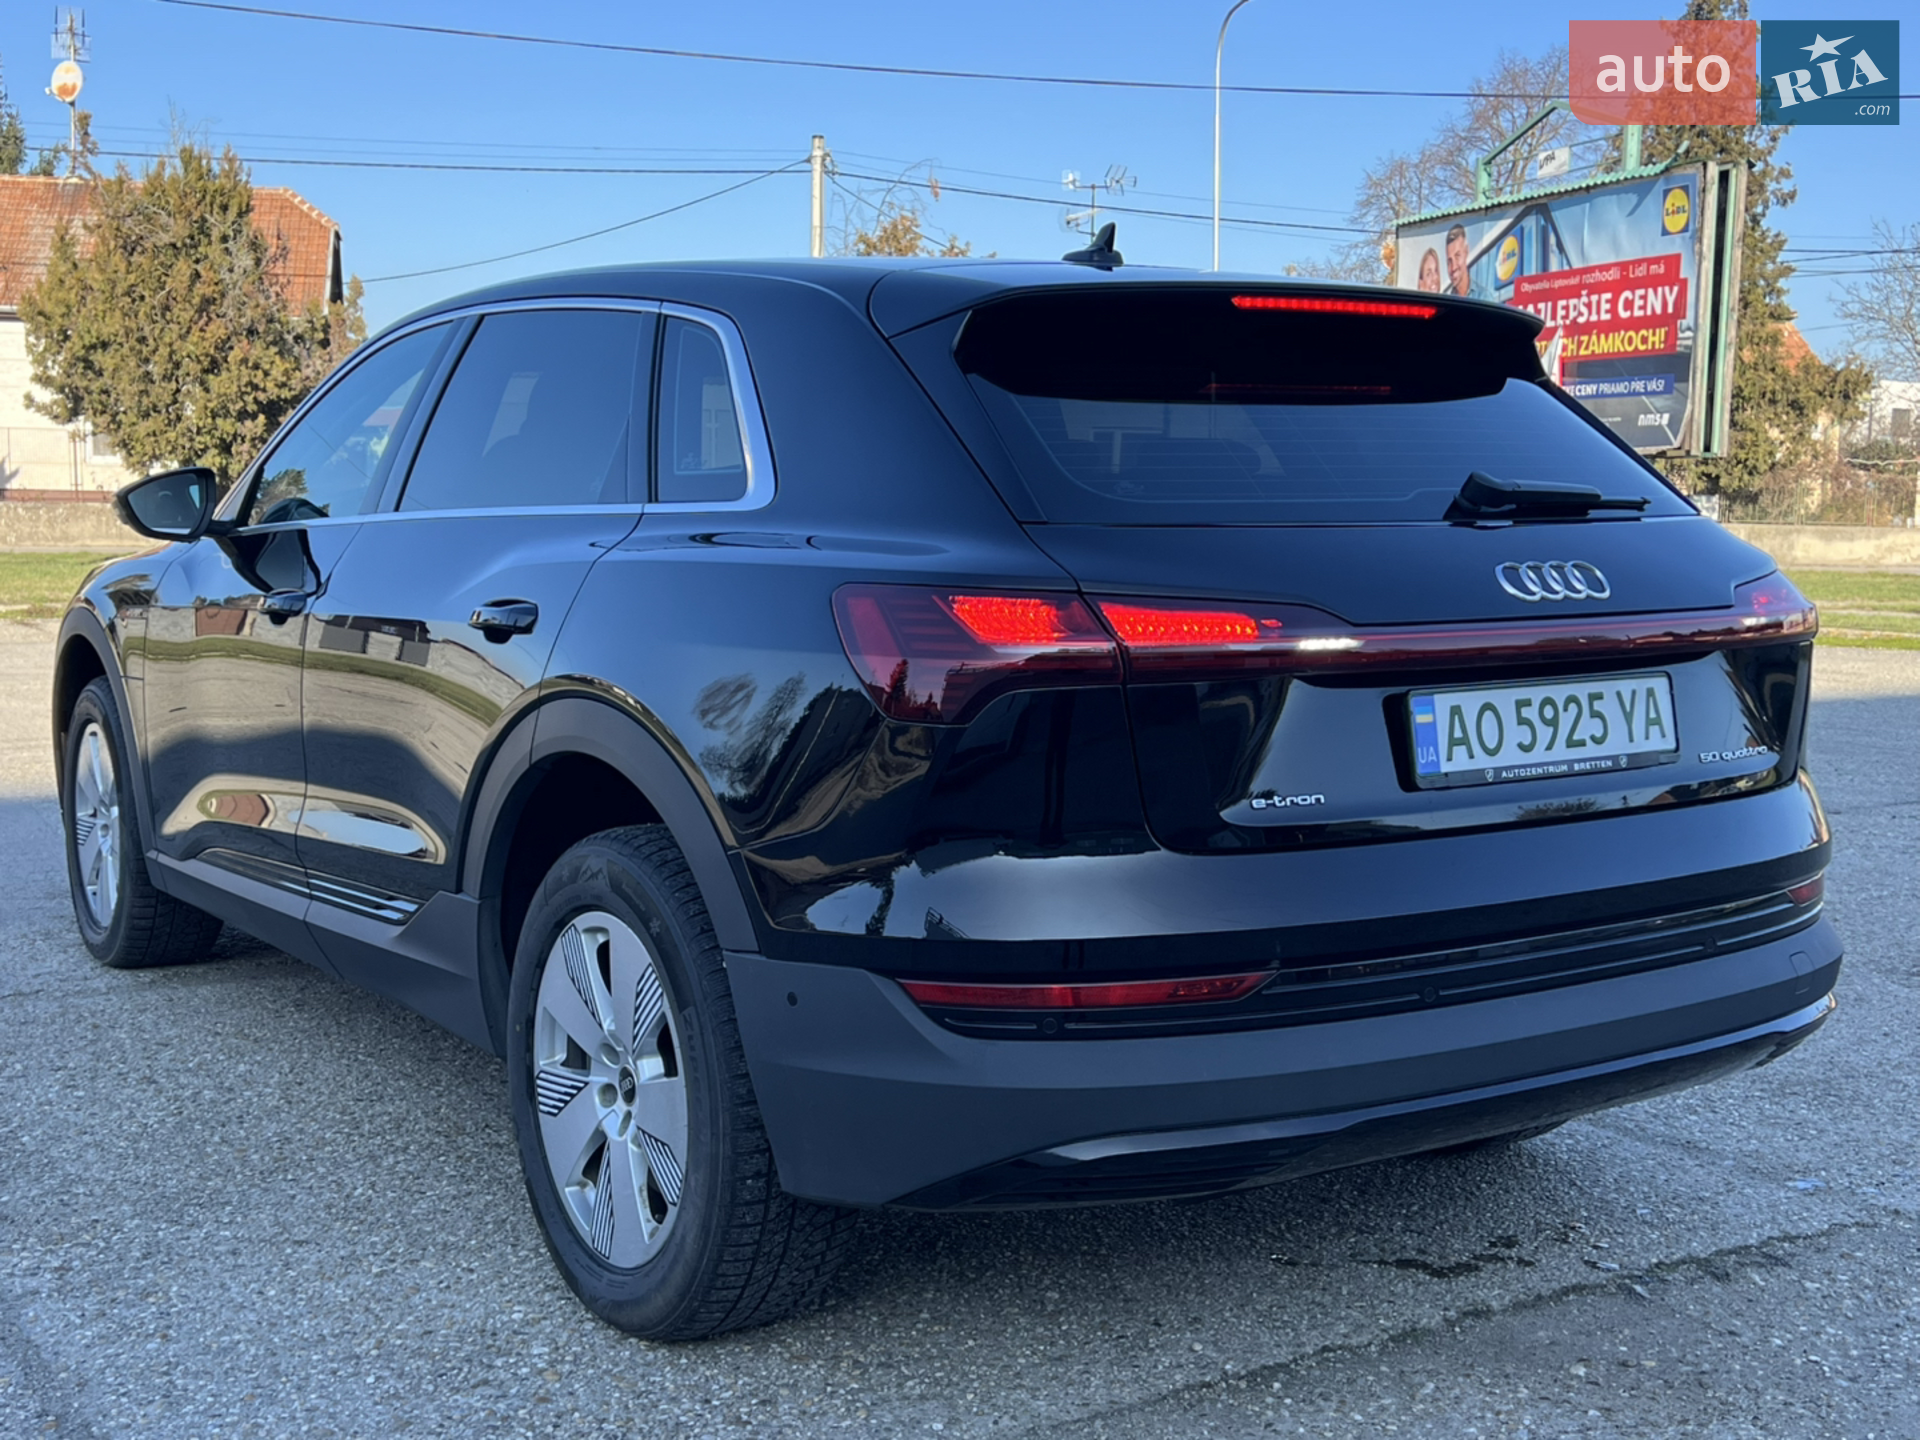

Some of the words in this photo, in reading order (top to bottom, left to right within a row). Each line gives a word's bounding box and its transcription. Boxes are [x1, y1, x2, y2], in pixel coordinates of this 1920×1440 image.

[1582, 267, 1621, 284] rozhodli
[1629, 264, 1647, 278] Lidl
[1649, 260, 1665, 275] má
[1617, 285, 1680, 319] CENY
[1579, 327, 1666, 356] ZÁMKOCH!
[1575, 383, 1598, 396] CENY
[1599, 381, 1630, 395] PRIAMO
[1446, 701, 1504, 762] AO
[1514, 691, 1609, 753] 5925
[1615, 686, 1667, 744] YA
[1418, 746, 1438, 764] UA
[1700, 751, 1720, 763] 50
[1721, 745, 1768, 761] quattro
[1501, 764, 1568, 779] AUTOZENTRUM
[1574, 759, 1613, 772] BRETTEN
[1251, 793, 1325, 809] e-tron
